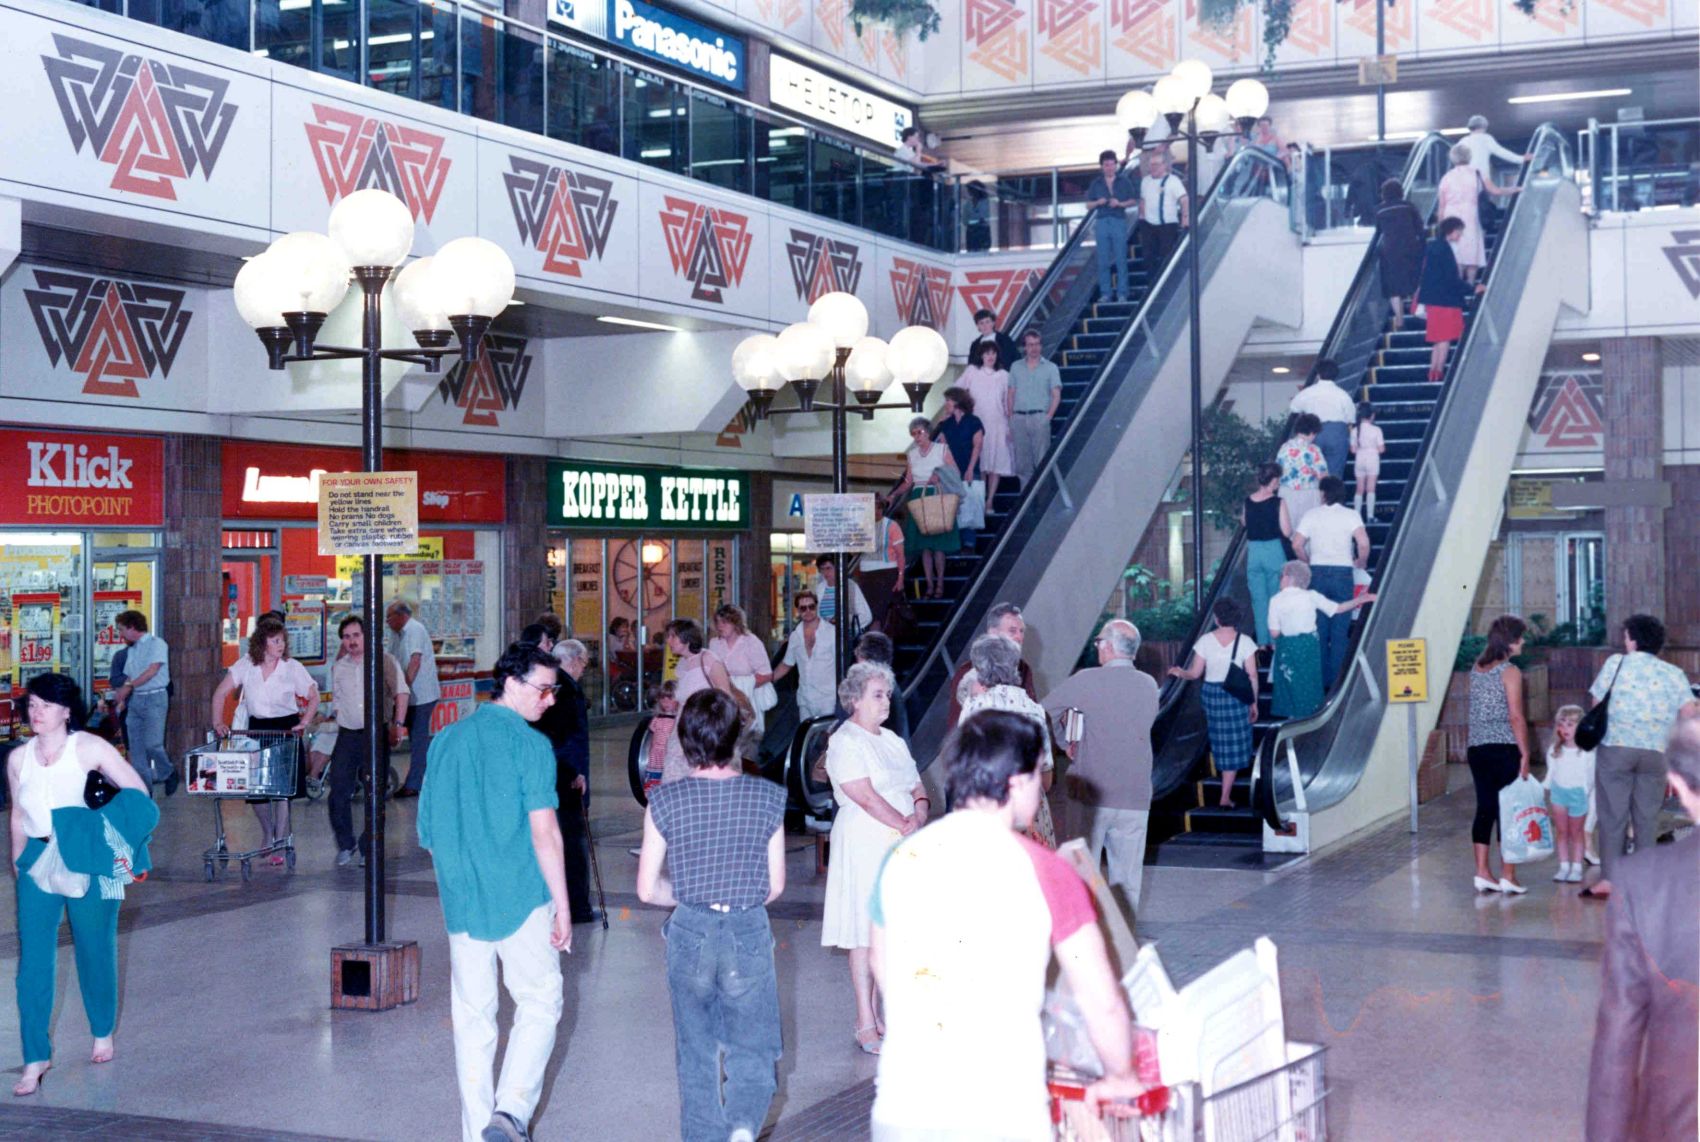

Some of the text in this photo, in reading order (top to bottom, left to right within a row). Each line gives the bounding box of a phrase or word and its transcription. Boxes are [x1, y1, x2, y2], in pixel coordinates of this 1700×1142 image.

[614, 1, 737, 82] Panasonic
[27, 442, 133, 489] Klick
[27, 495, 133, 516] PHOTOPOINT
[563, 471, 740, 521] KOPPER KETTLE
[329, 520, 350, 528] Carry
[377, 512, 395, 520] dogs
[20, 643, 52, 663] £1.99
[440, 683, 472, 699] ANADA
